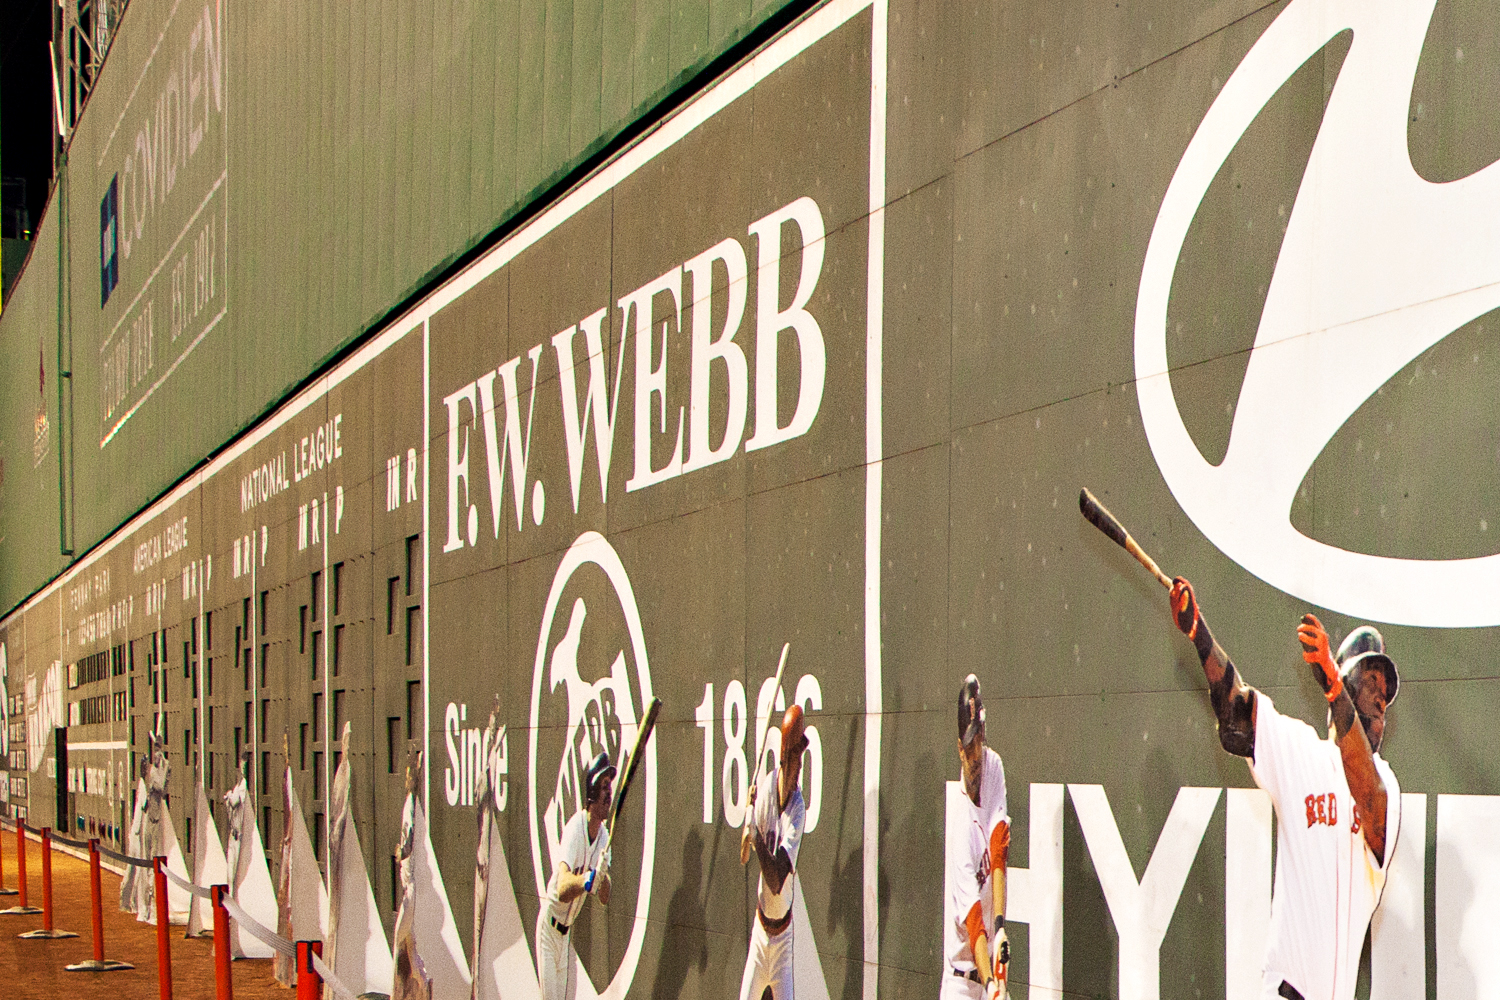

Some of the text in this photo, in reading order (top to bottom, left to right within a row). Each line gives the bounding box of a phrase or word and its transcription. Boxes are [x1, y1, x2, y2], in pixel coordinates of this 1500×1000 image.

[121, 0, 222, 260] COVIDIEN
[552, 195, 827, 515] WEBB
[241, 413, 343, 513] NATIONAL LEAGUE
[335, 485, 344, 534] P
[406, 447, 417, 503] R
[311, 498, 320, 545] R
[695, 673, 823, 834] 1866
[1304, 792, 1338, 829] RED
